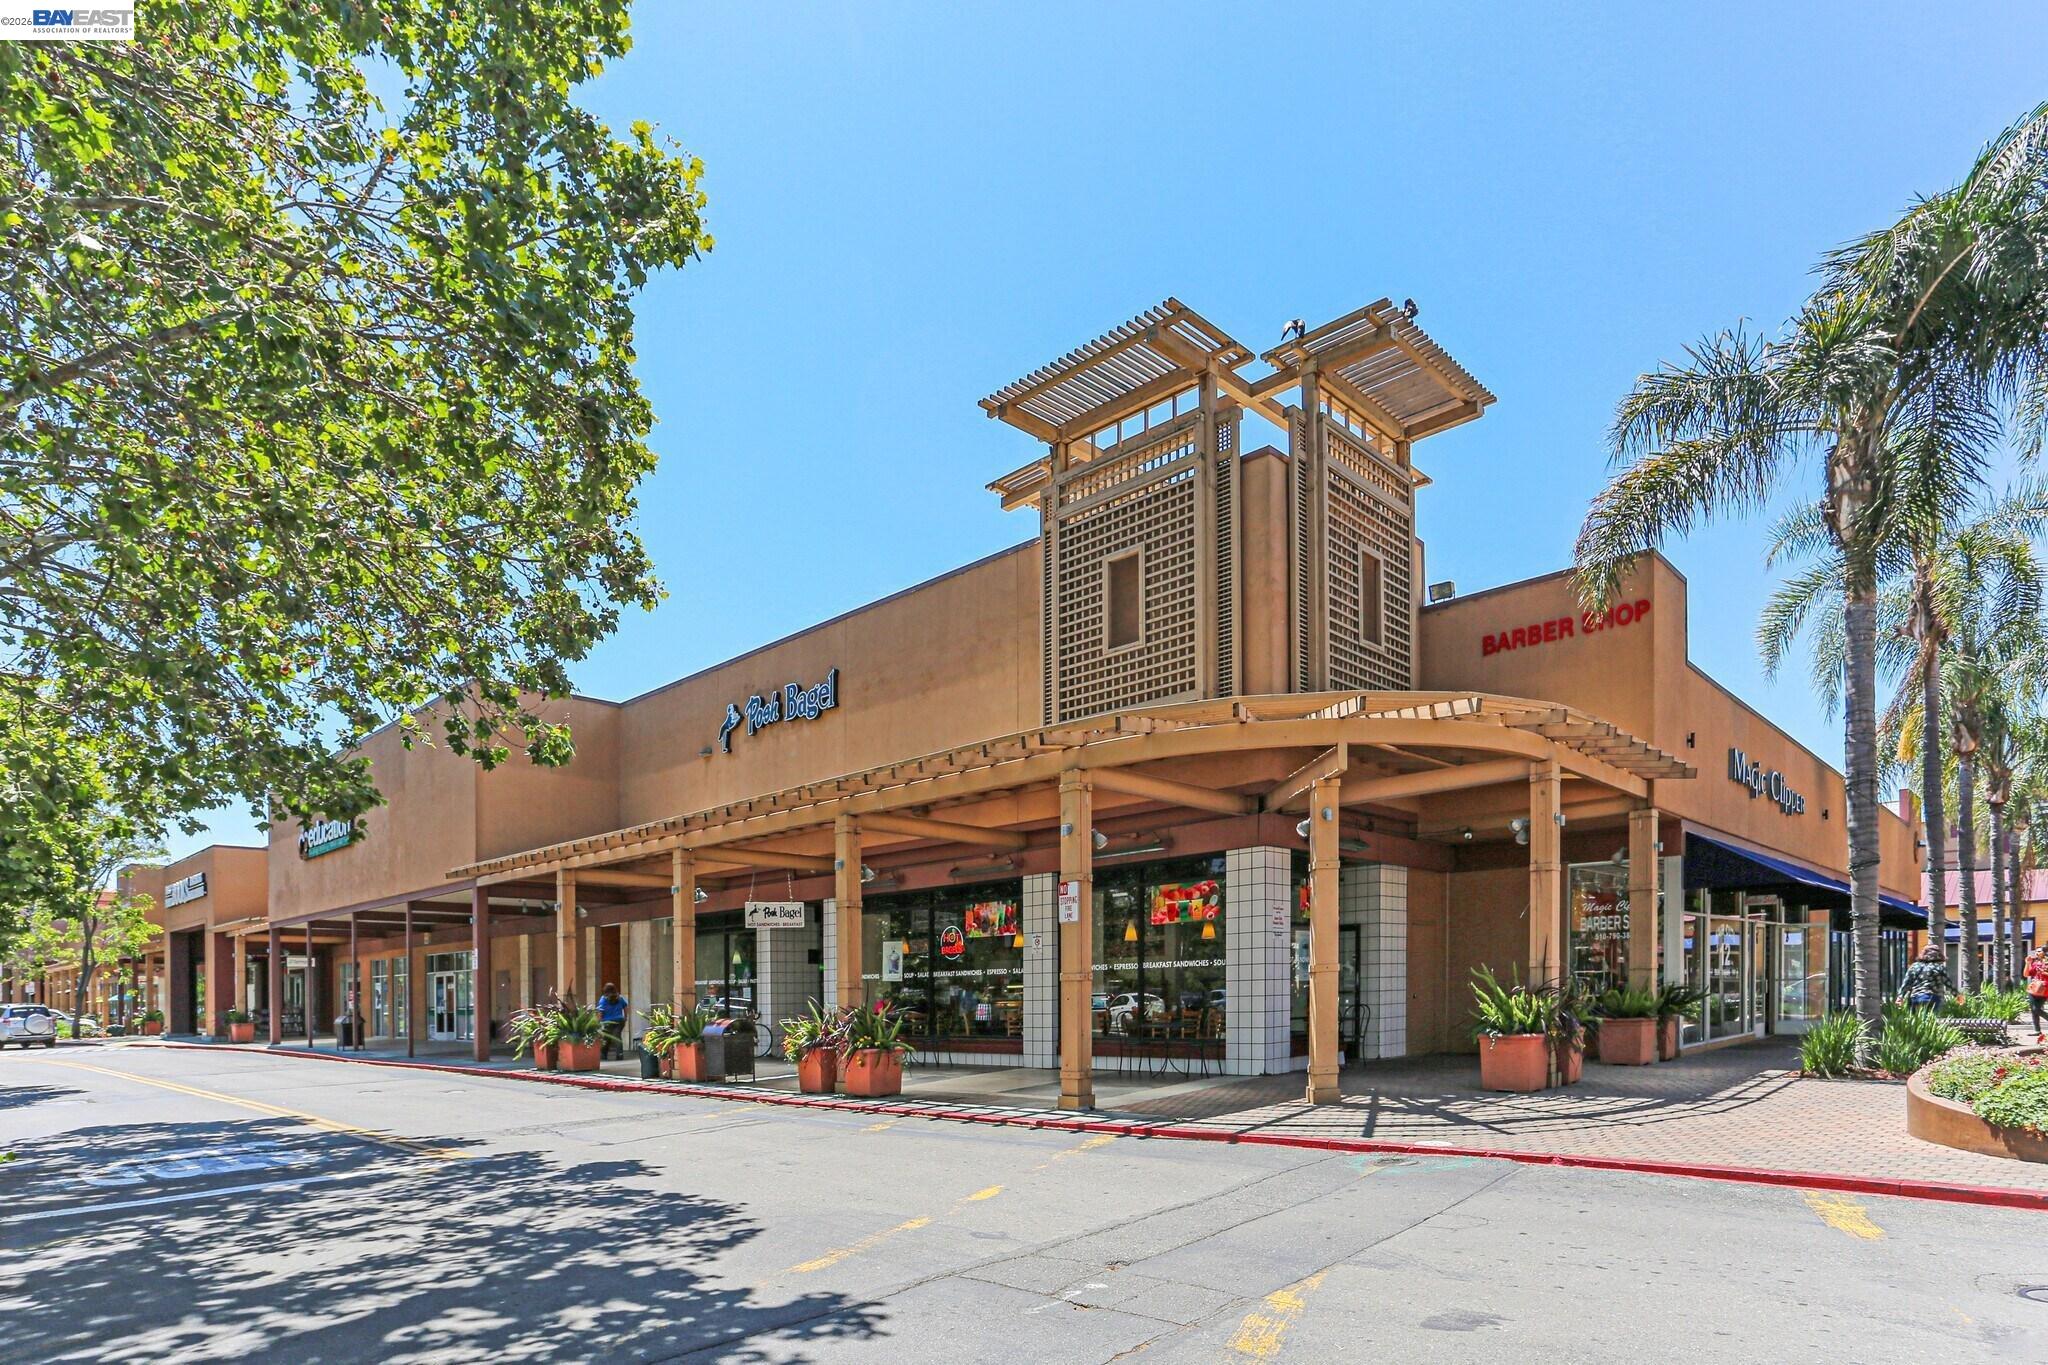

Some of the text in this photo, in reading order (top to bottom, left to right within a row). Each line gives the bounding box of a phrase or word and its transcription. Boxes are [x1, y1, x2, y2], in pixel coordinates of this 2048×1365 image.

[1482, 617, 1574, 656] BARBER
[745, 668, 837, 736] Posh Bagel
[1059, 884, 1068, 895] NO
[780, 906, 802, 919] Bagel
[1582, 902, 1612, 913] Magic
[1580, 915, 1621, 931] BARBER
[943, 932, 960, 943] HOT
[1142, 961, 1172, 969] BREAKFAST
[1173, 960, 1209, 968] SANDWICHES
[956, 969, 982, 977] SANDWICHES
